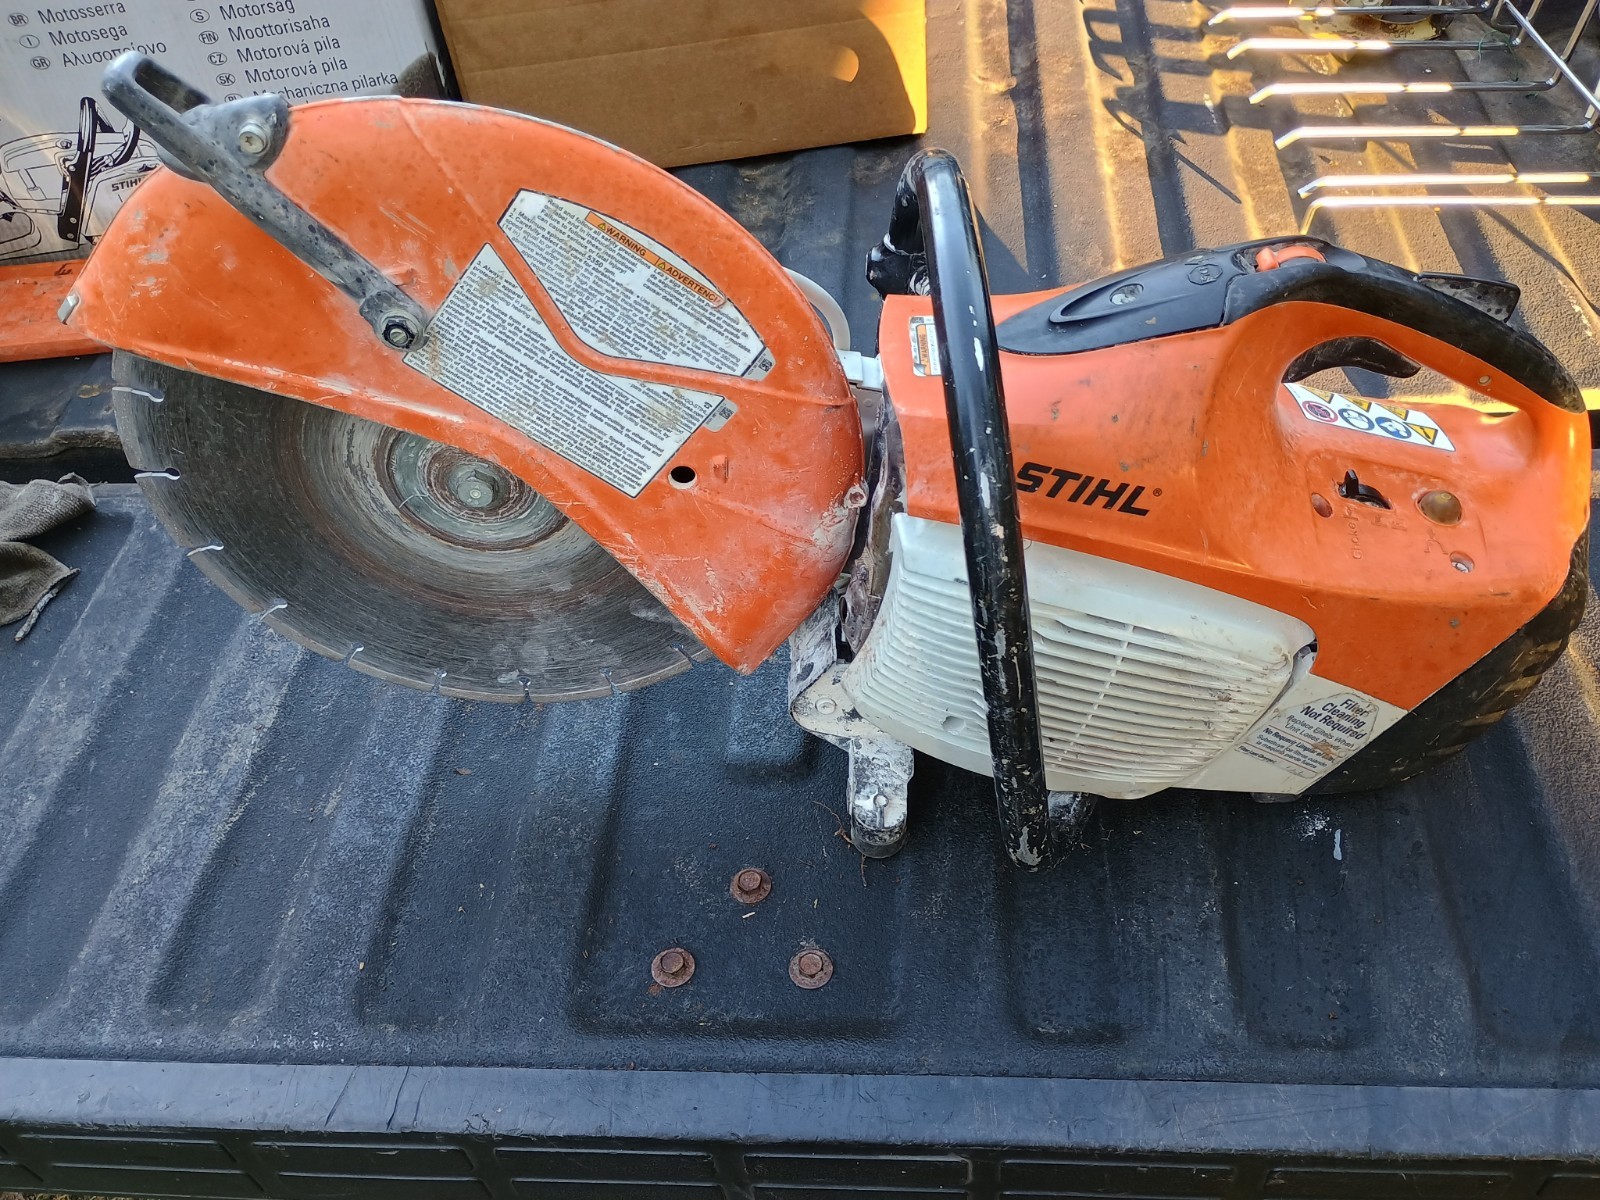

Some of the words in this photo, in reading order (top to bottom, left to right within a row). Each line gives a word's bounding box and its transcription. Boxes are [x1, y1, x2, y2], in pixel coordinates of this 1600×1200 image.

[37, 2, 126, 24] Motosserra
[48, 25, 128, 46] Motosega
[228, 15, 330, 42] Moottorisaha
[62, 42, 167, 67] Αλυσοπίονο
[237, 39, 310, 63] Motorová
[314, 36, 341, 55] pila
[245, 60, 317, 84] Motorová
[322, 57, 348, 75] pila
[253, 80, 349, 99] haniczna
[352, 72, 399, 92] pilarka
[605, 226, 647, 256] WARNING
[586, 254, 603, 268] 5350
[1016, 462, 1149, 516] STIHL
[1322, 702, 1366, 729] Cleaning
[1340, 699, 1368, 717] Filter
[1300, 706, 1322, 720] Not
[1319, 714, 1368, 740] Required
